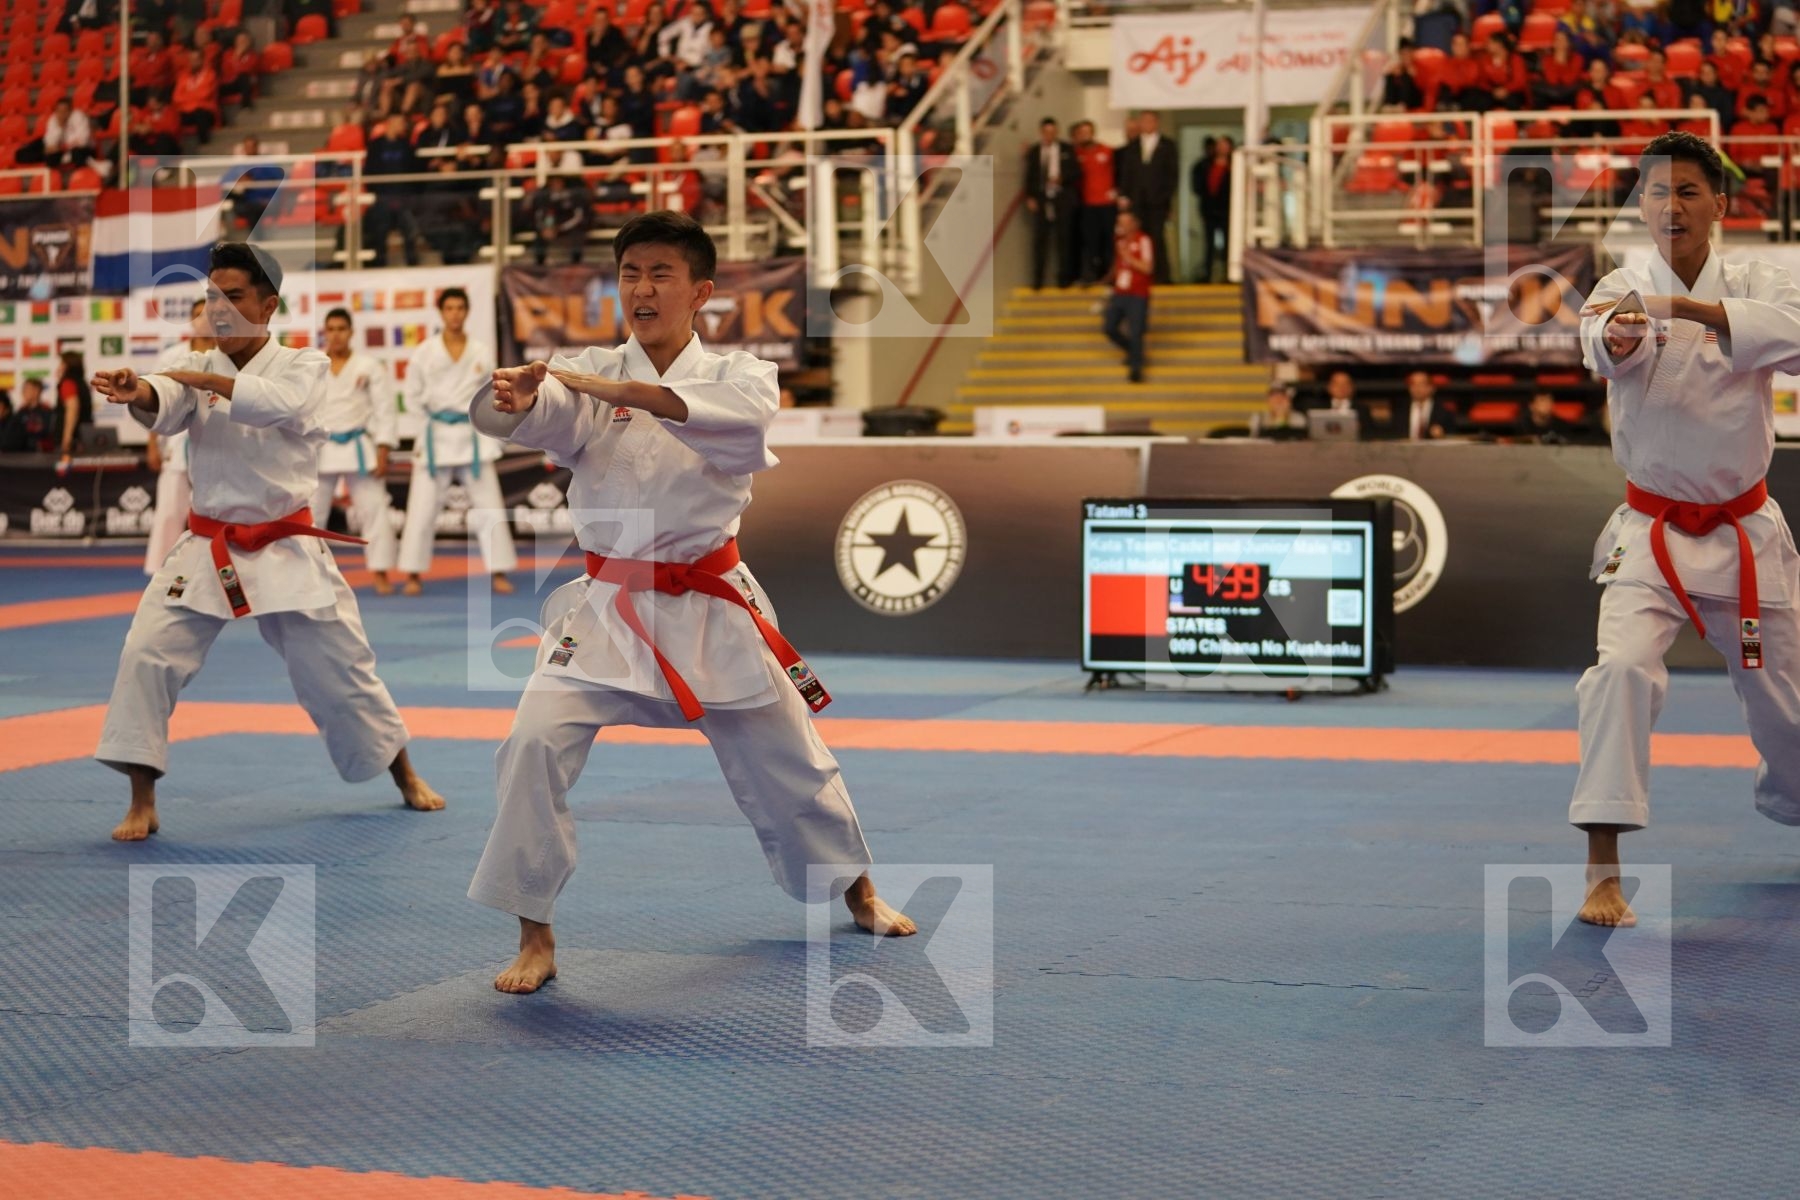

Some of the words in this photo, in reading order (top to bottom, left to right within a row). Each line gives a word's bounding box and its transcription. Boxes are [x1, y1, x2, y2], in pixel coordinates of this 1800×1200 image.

[1355, 479, 1404, 493] WORLD
[1085, 504, 1135, 519] Tatami
[1136, 504, 1147, 519] 3
[1165, 617, 1227, 635] STATES
[1199, 638, 1260, 656] Chibana
[1261, 639, 1284, 656] No
[1286, 639, 1362, 658] Kushanku
